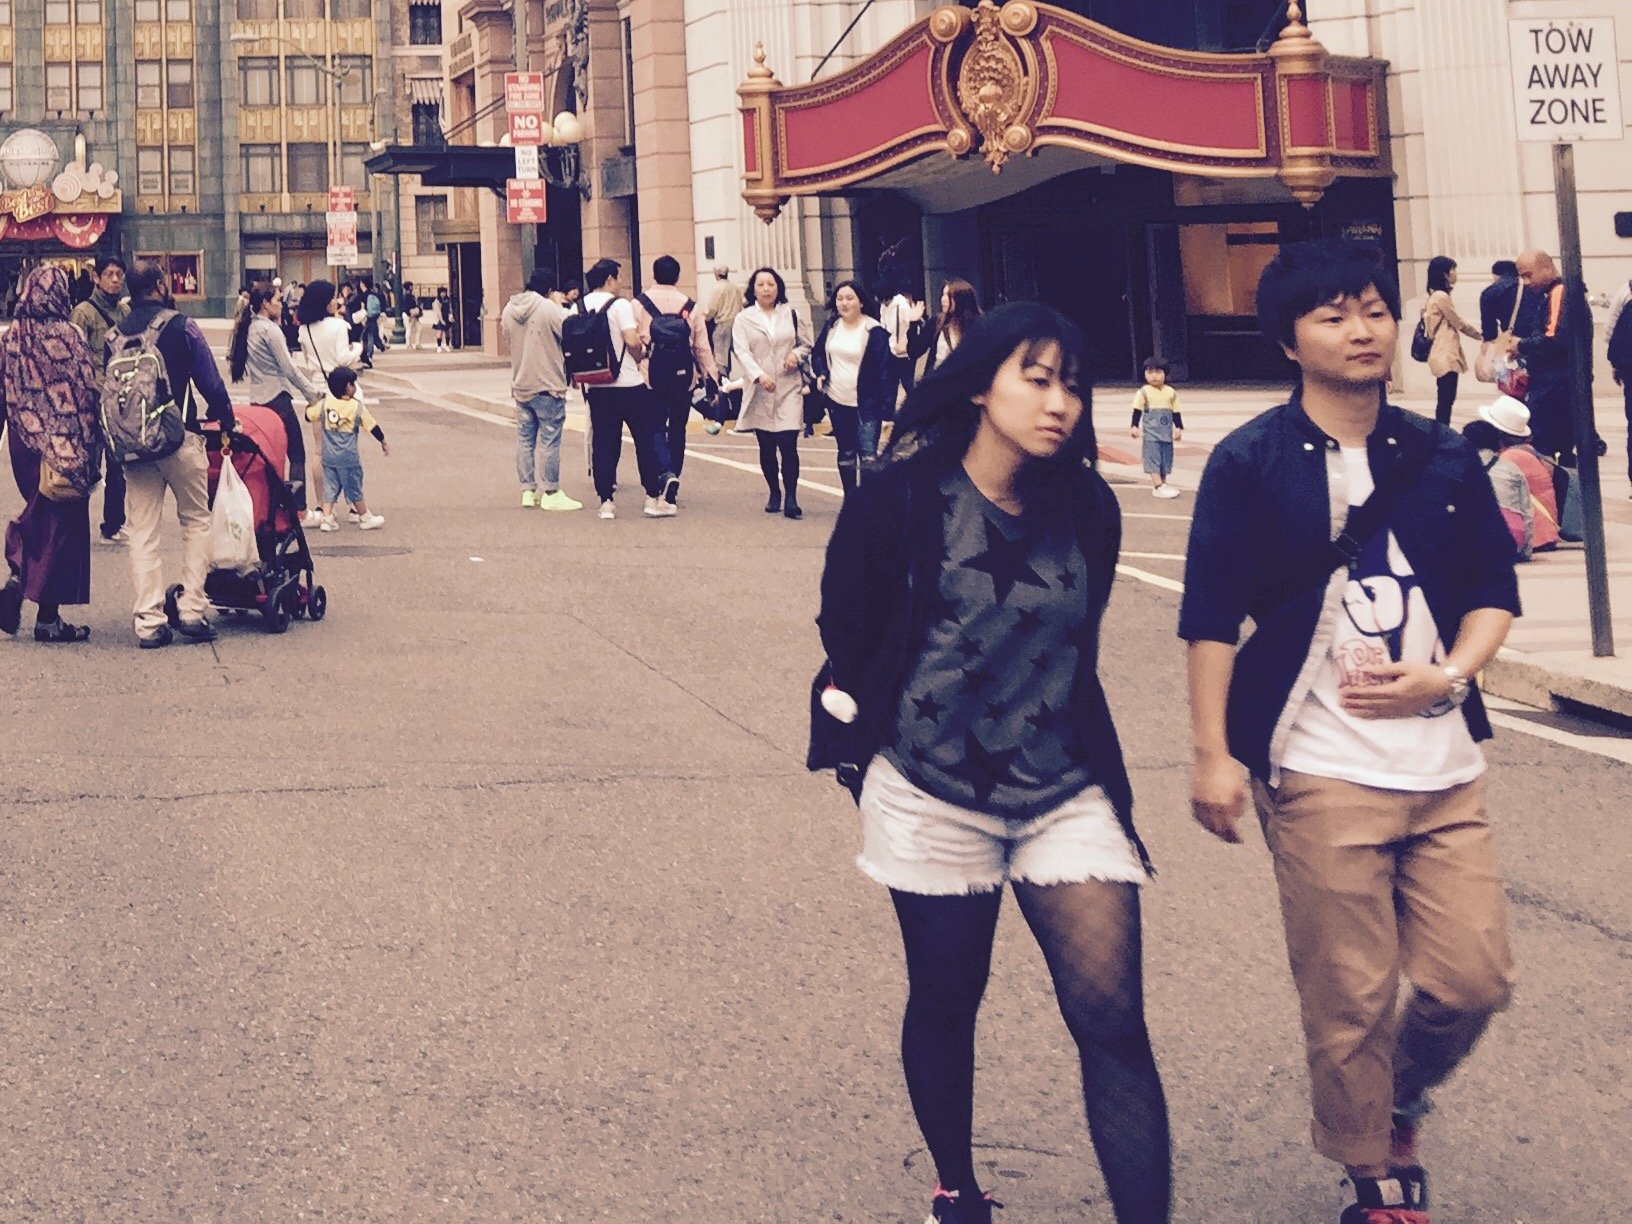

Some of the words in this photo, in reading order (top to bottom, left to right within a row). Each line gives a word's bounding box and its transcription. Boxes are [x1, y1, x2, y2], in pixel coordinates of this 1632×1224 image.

[1529, 27, 1593, 54] TOW
[1528, 63, 1603, 89] AWAY
[514, 114, 538, 129] NO
[1529, 98, 1607, 125] ZONE
